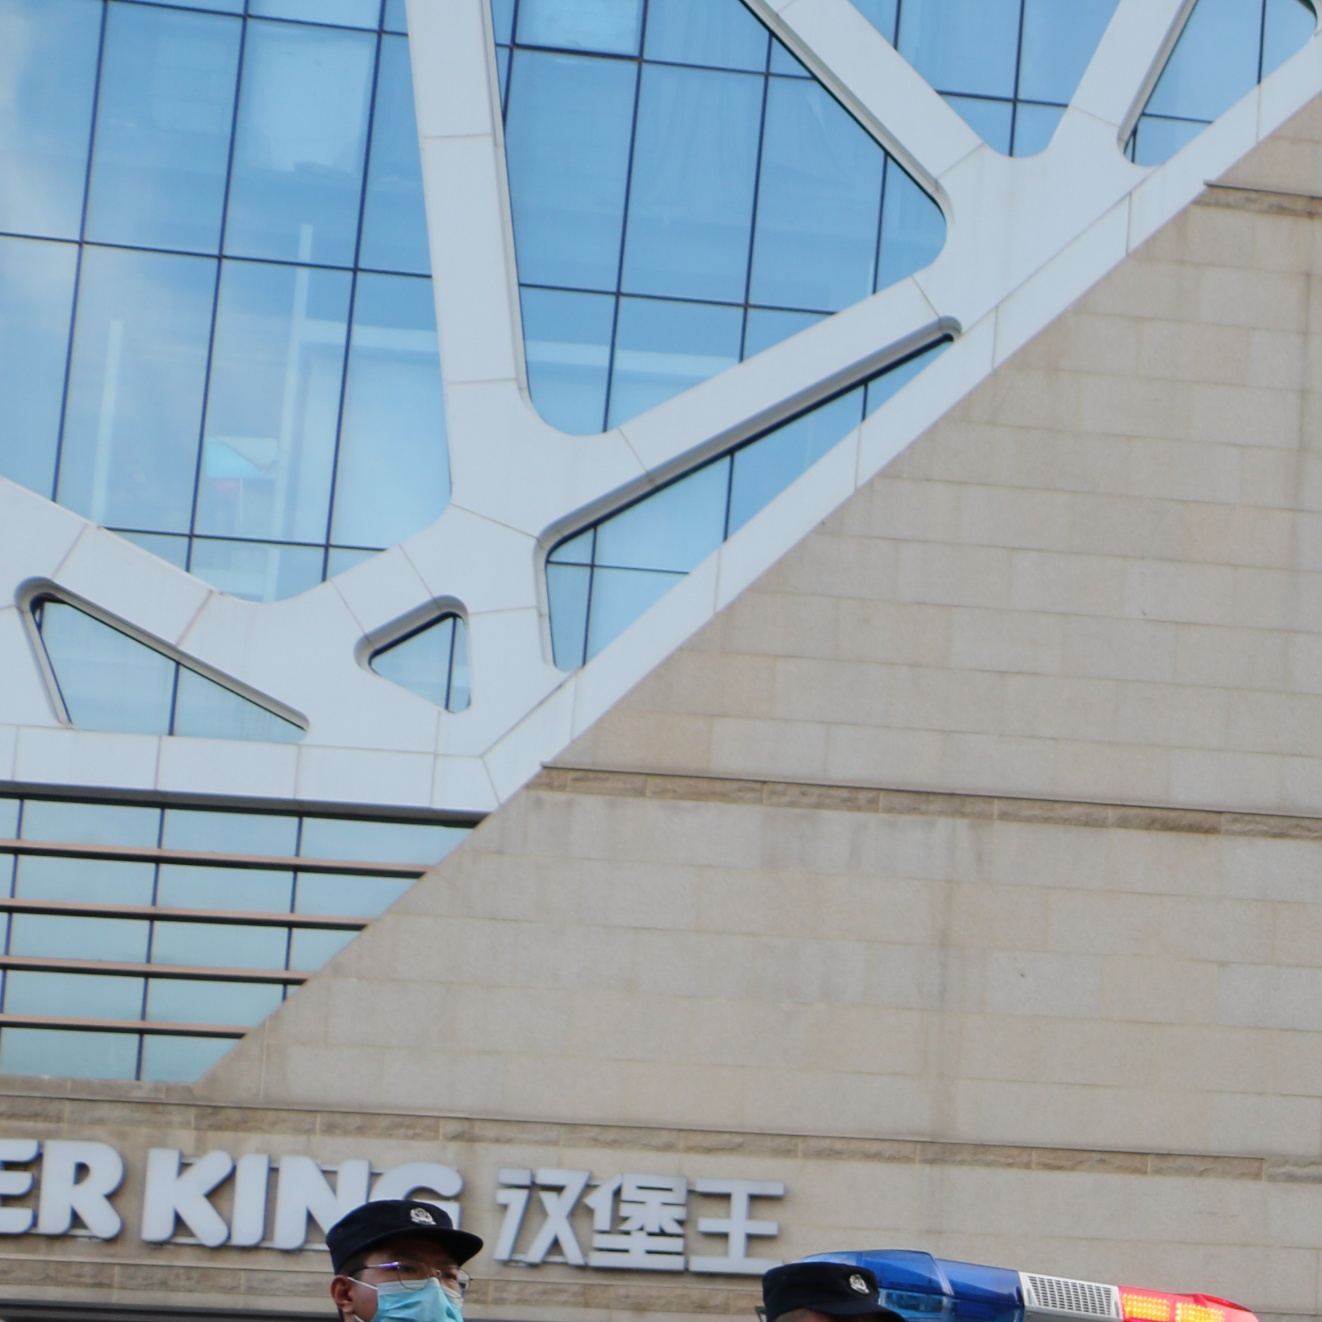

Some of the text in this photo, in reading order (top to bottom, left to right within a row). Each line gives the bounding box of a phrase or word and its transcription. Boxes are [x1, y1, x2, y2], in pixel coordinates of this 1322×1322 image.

[141, 1149, 464, 1250] KING
[494, 1167, 785, 1275] 汉堡王
